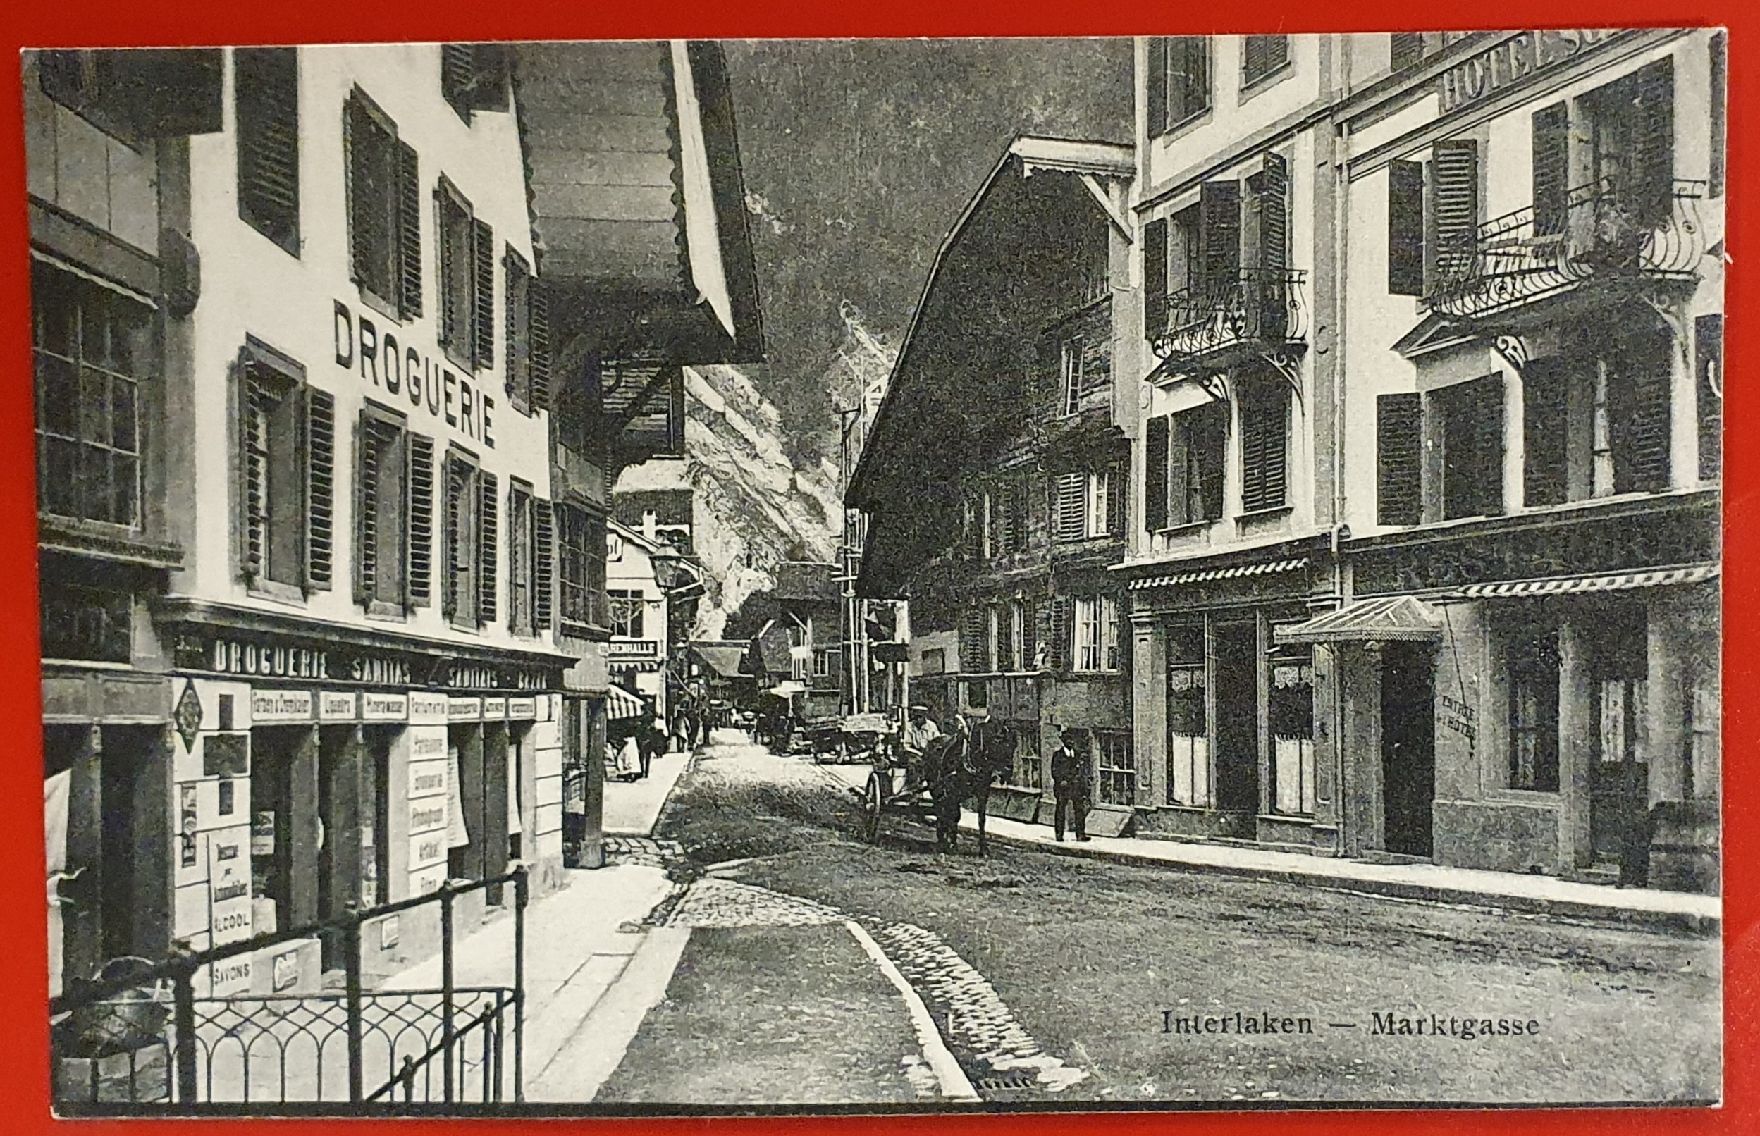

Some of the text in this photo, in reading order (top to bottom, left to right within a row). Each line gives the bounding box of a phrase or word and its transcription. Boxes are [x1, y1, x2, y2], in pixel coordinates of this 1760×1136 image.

[1443, 30, 1554, 112] HOTEL
[333, 298, 495, 449] DROGUERIE
[214, 639, 329, 680] DROGUERIE
